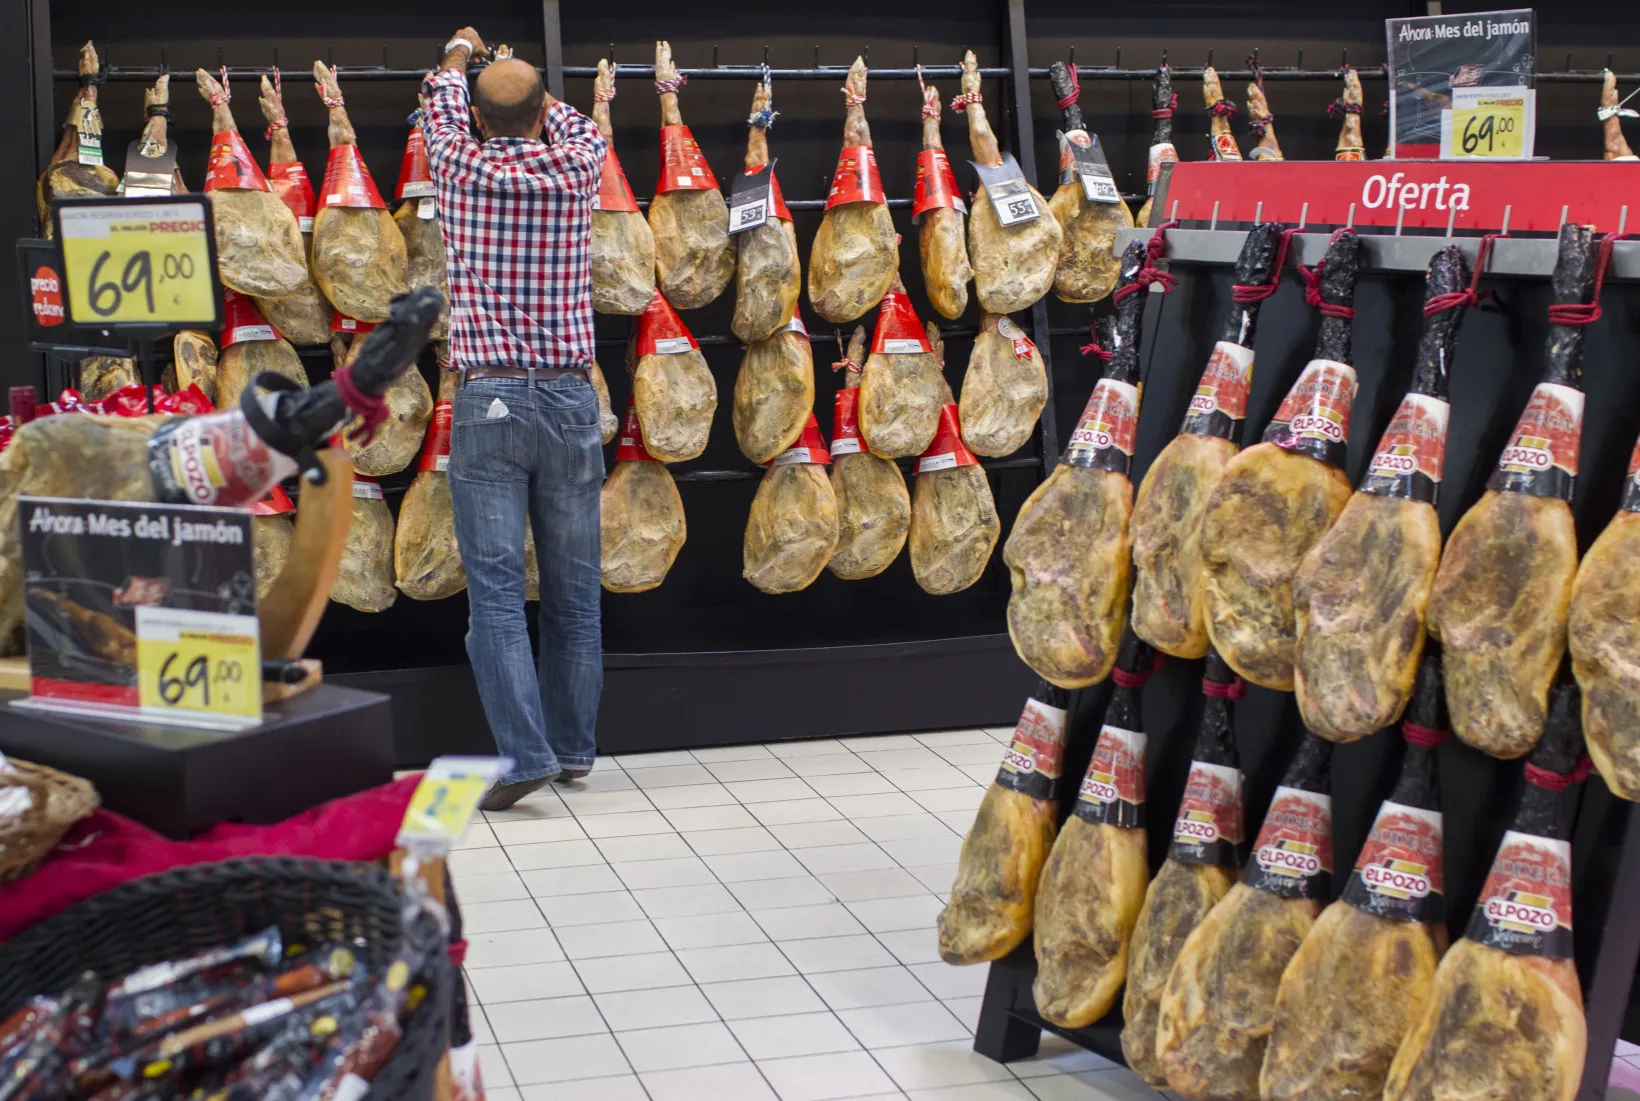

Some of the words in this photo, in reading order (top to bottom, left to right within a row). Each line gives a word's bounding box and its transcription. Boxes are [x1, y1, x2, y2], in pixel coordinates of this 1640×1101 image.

[1435, 24, 1460, 39] Mes
[1463, 21, 1483, 37] del
[1486, 19, 1529, 39] jamón
[1496, 99, 1524, 107] PRECIO
[1362, 172, 1470, 211] Oferta
[89, 513, 131, 538] Mes
[134, 514, 170, 539] del
[173, 516, 244, 547] jamón
